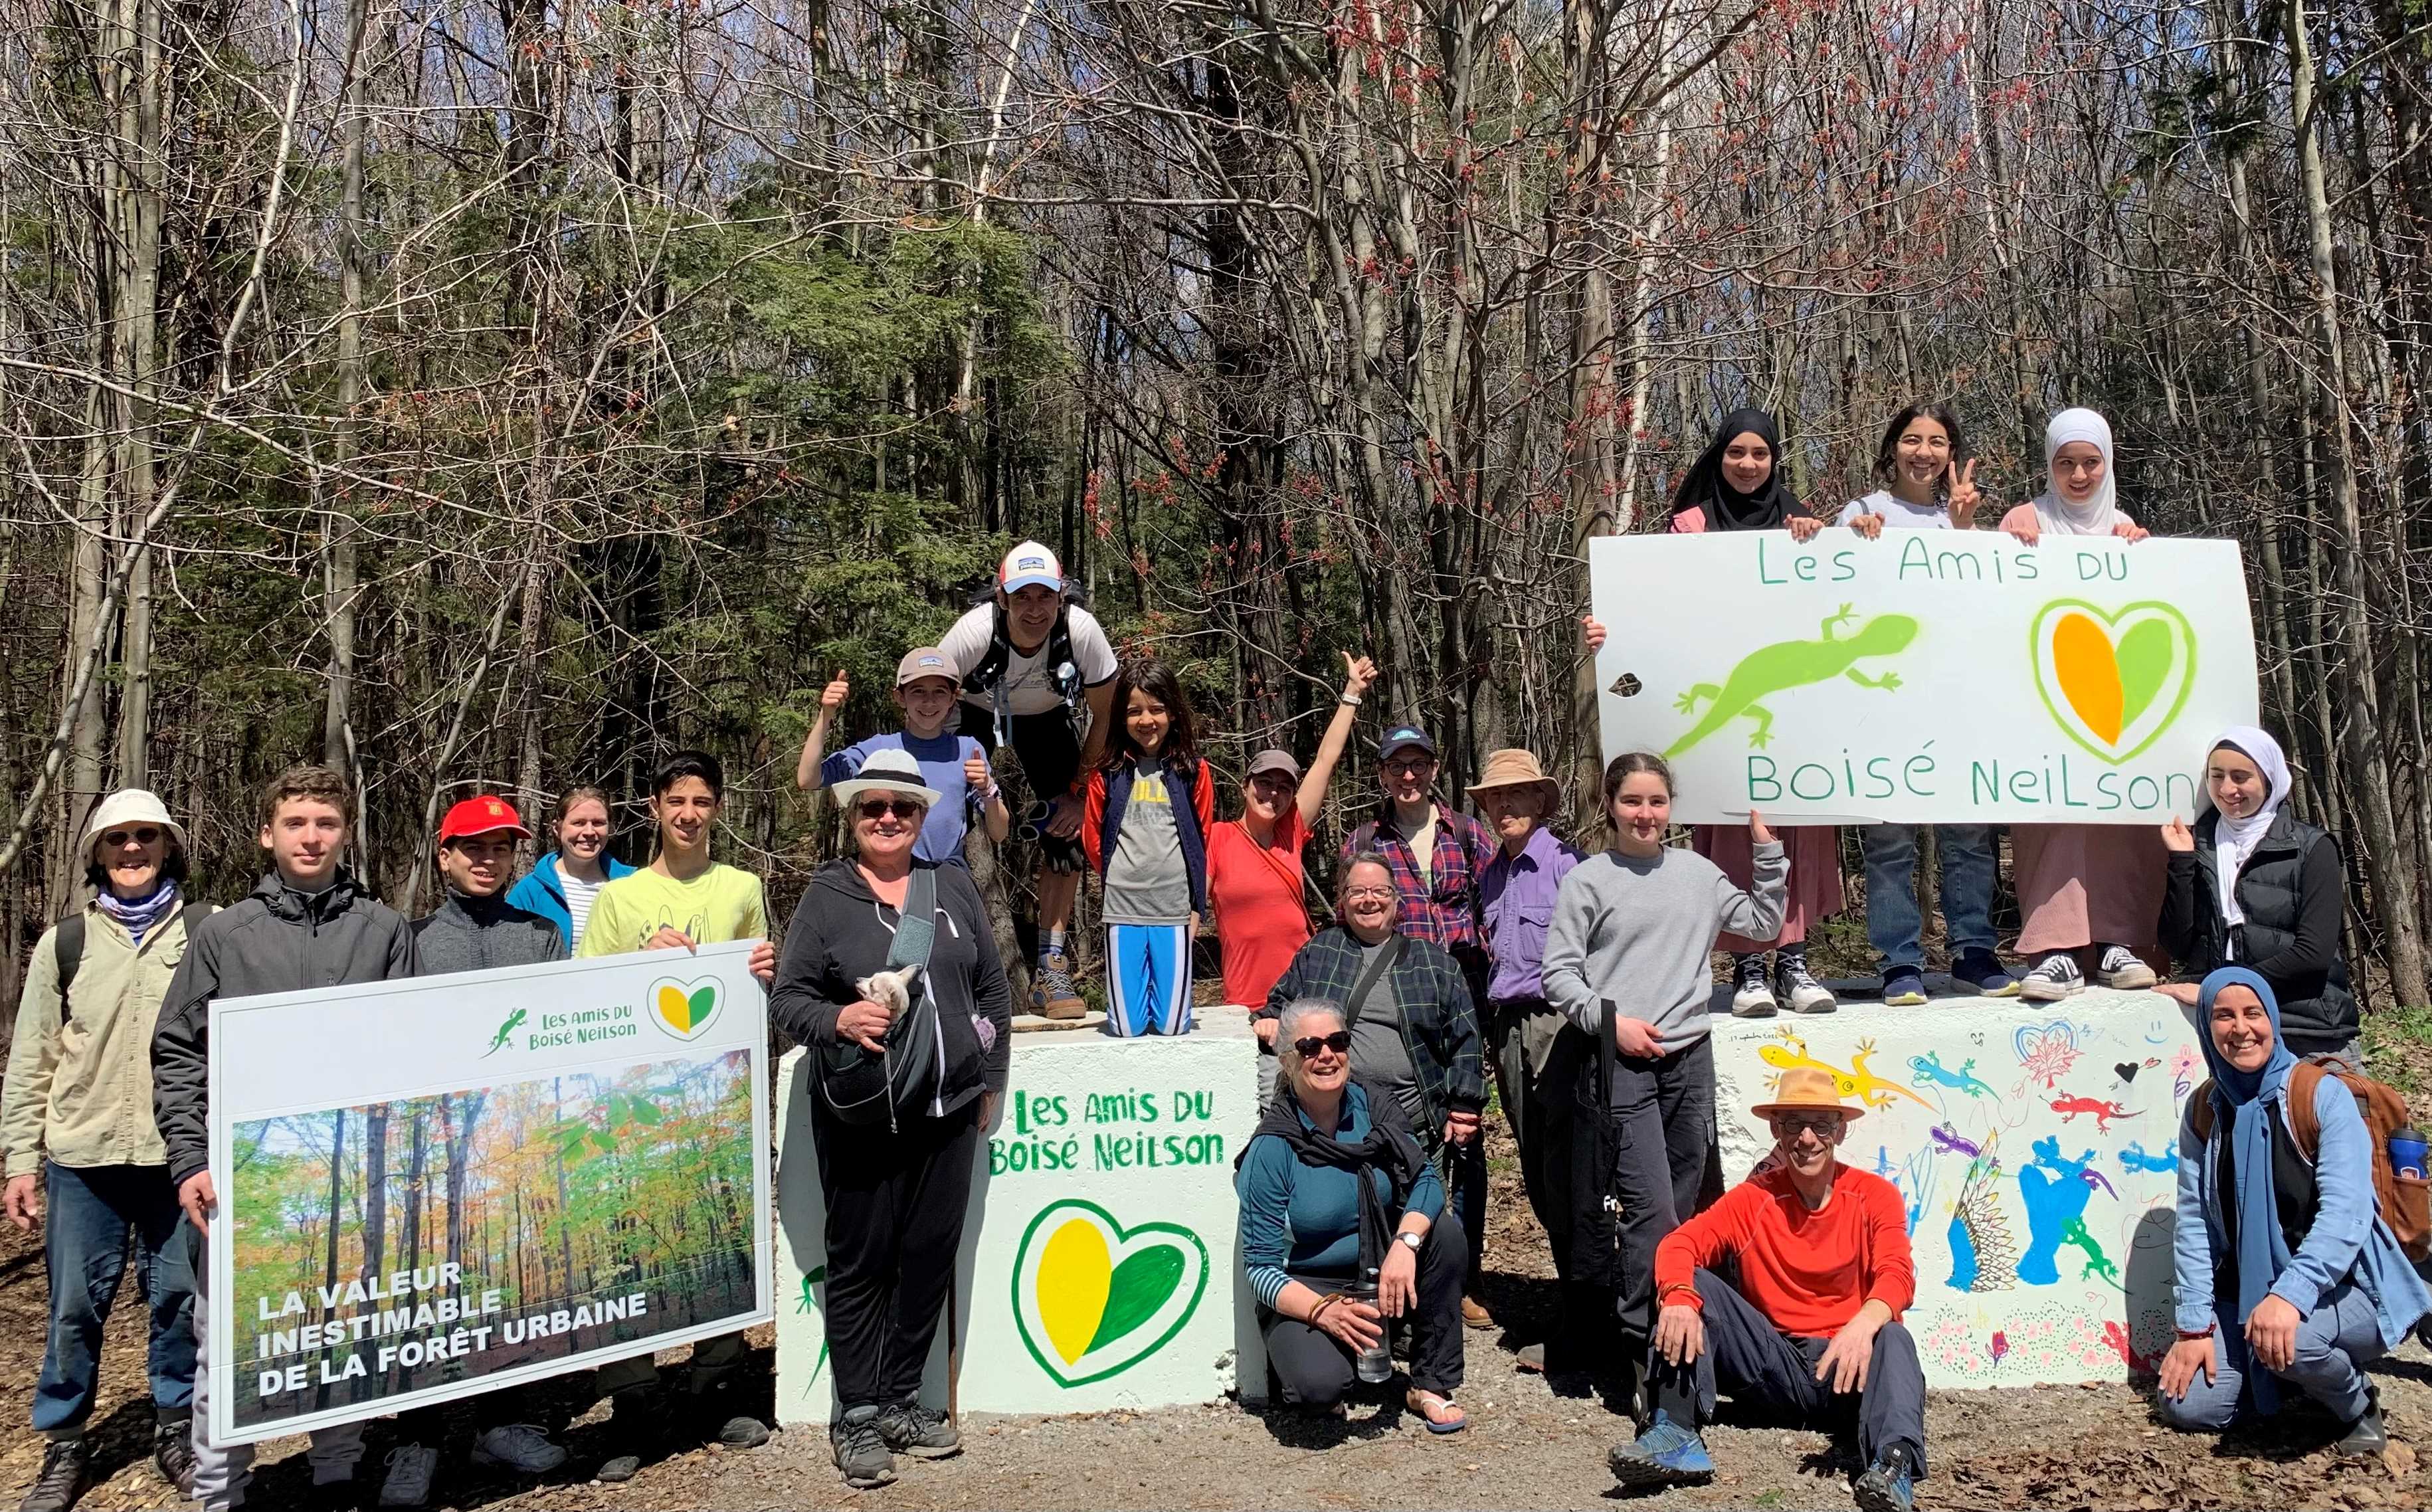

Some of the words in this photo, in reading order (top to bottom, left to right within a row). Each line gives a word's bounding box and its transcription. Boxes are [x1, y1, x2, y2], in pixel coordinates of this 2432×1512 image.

[1758, 537, 1855, 585] Les
[1899, 536, 2039, 584] Amis
[1132, 781, 1169, 803] ULL
[1747, 739, 1936, 802] Boisé
[529, 1028, 573, 1051] Boisé
[542, 1012, 567, 1030] Les
[571, 1008, 609, 1024] Amis
[1014, 1089, 1069, 1136] Les
[1083, 1087, 1159, 1125] Amis
[988, 1131, 1080, 1176] Boisé
[260, 1291, 307, 1321] LA
[318, 1262, 462, 1309] VALEUR
[260, 1289, 502, 1358] INESTIMABLE
[260, 1364, 308, 1396] DE
[321, 1354, 367, 1384] LA
[379, 1327, 492, 1373] FORÊT
[504, 1293, 647, 1345] URBAINE
